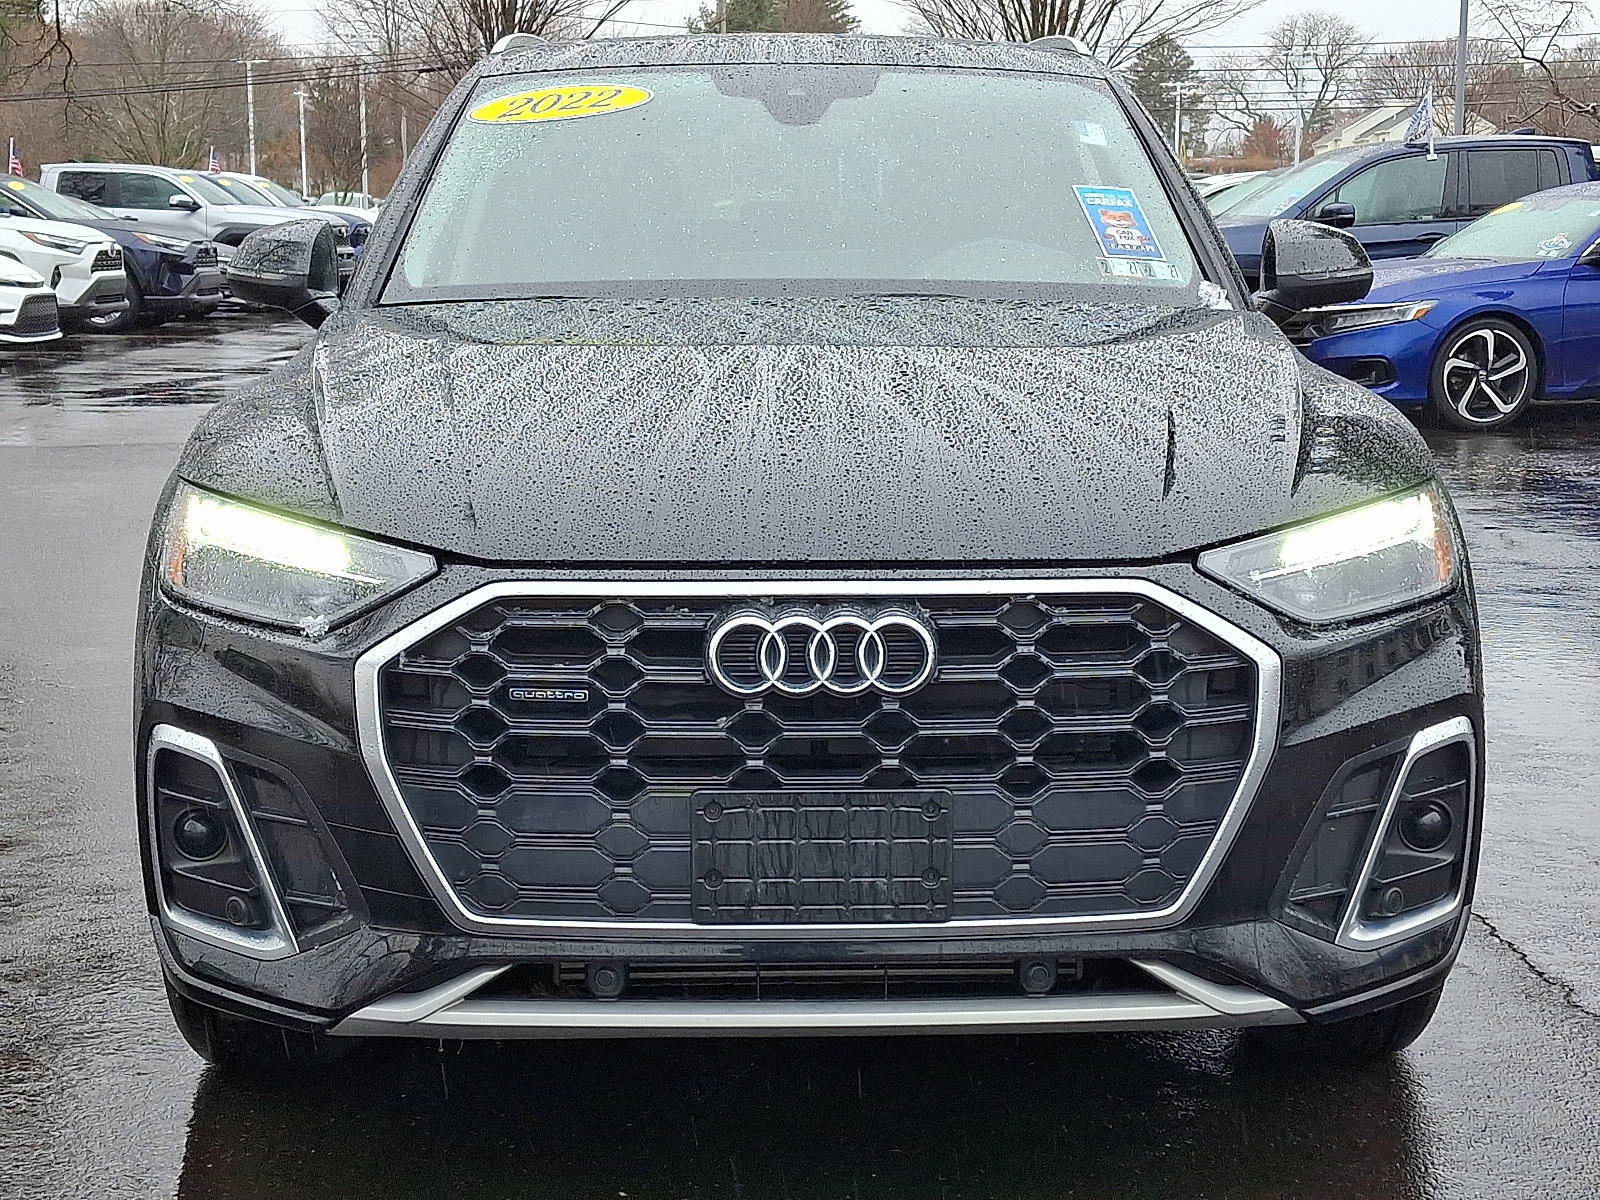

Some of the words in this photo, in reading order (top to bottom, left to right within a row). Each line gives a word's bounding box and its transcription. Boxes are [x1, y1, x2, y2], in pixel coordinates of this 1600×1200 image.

[497, 89, 622, 119] 2022
[1085, 197, 1134, 208] CARFAX
[512, 690, 585, 701] quattro
